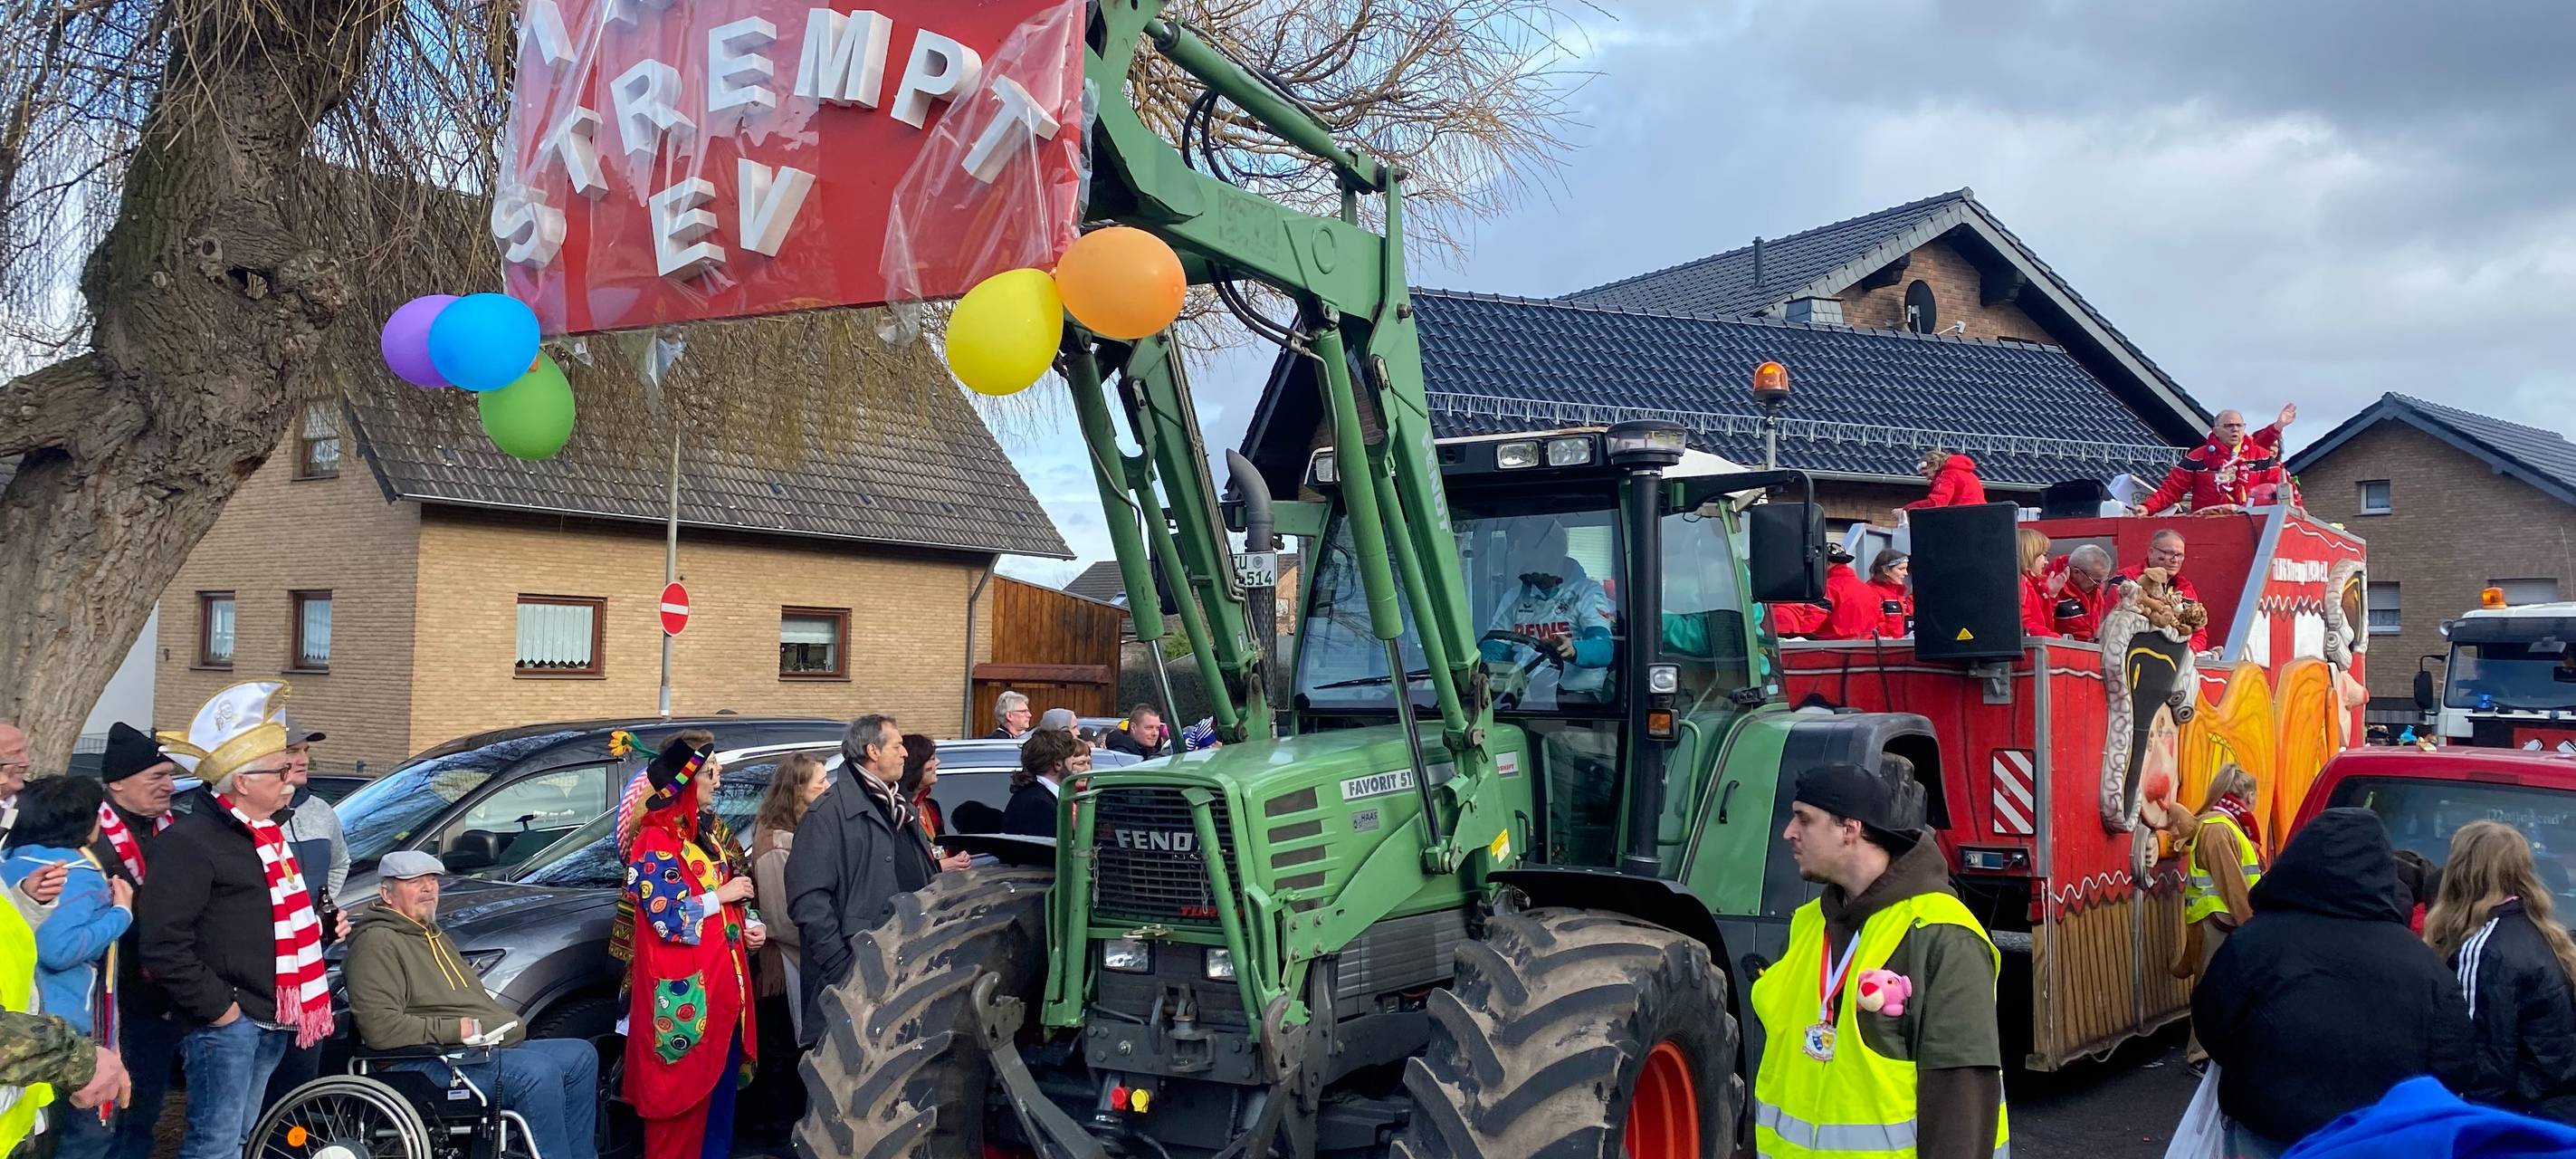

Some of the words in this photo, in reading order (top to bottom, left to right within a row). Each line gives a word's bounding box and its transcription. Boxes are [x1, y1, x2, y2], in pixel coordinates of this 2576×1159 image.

[1245, 570, 1272, 586] 514
[1513, 621, 1572, 638] REWE
[1348, 773, 1397, 797] FAVORIT
[1400, 771, 1416, 788] 51
[1114, 829, 1200, 851] FEND
